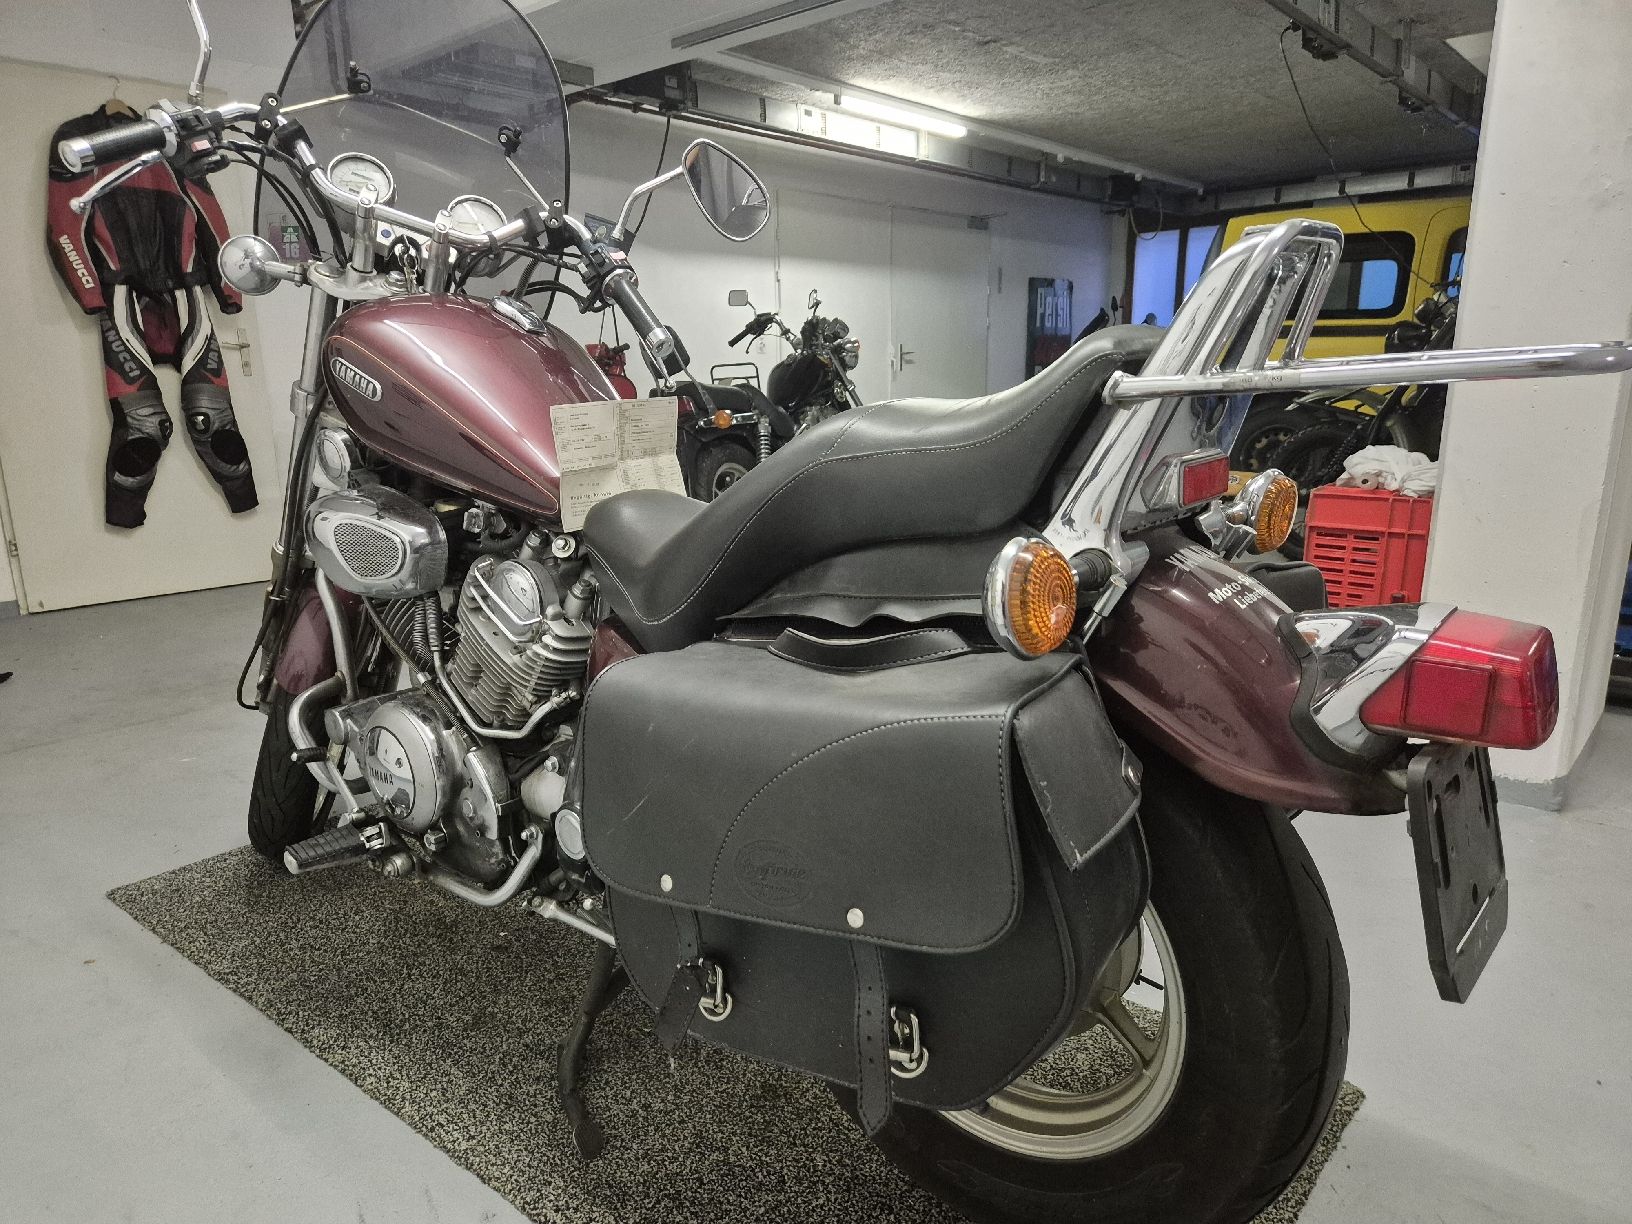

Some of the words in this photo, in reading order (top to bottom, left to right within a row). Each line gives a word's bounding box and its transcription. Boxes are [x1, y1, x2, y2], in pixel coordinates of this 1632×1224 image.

[59, 235, 95, 289] VANUCCI
[282, 243, 300, 258] 16
[1036, 287, 1070, 328] Persil
[206, 333, 220, 369] VAN
[336, 360, 374, 398] YAMAHA
[367, 766, 394, 786] AMAHA
